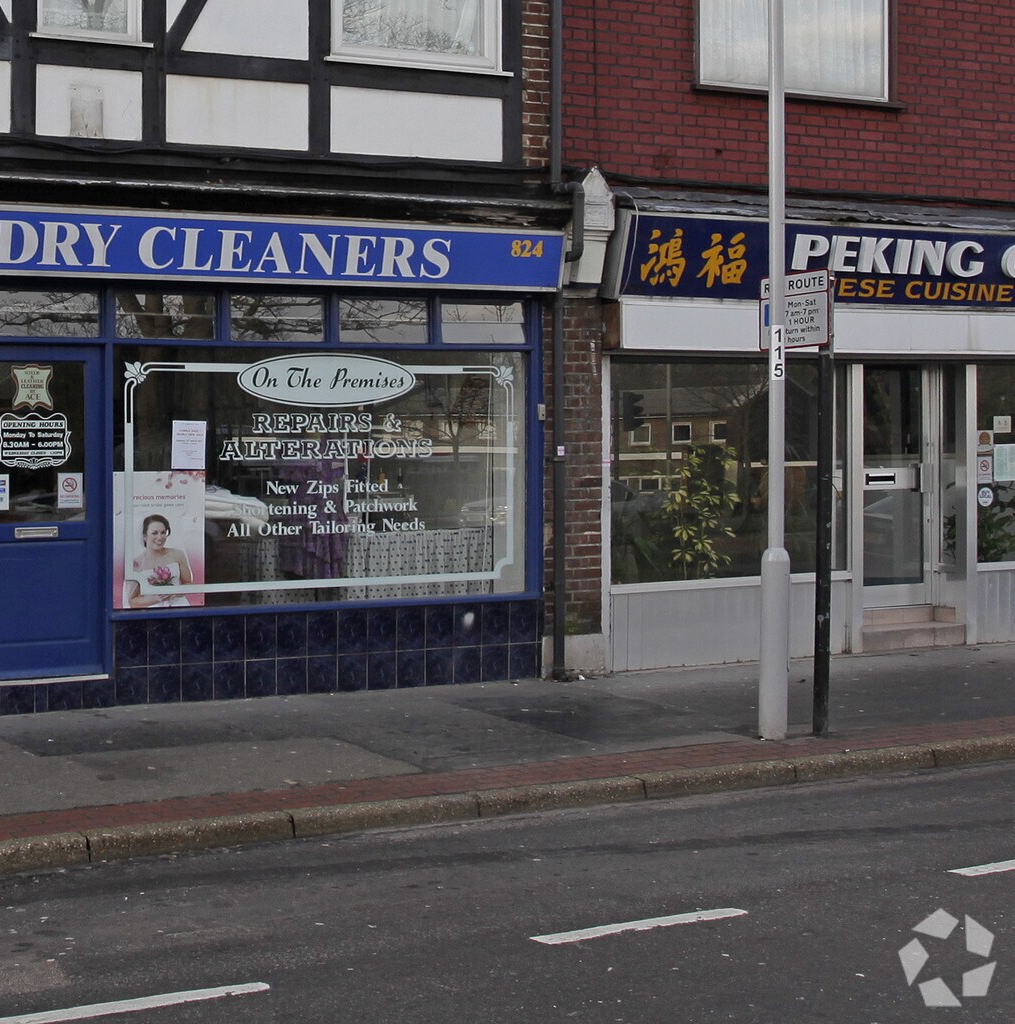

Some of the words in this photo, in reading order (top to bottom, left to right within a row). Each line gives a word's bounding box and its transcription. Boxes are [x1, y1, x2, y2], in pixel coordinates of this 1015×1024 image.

[138, 226, 451, 279] CLEANERS
[511, 239, 544, 258] 824
[791, 233, 985, 278] PEKING
[788, 276, 824, 290] ROUTE
[905, 280, 1012, 302] CUISINE
[787, 299, 817, 309] Mon-Sat
[785, 327, 799, 335] turn
[800, 325, 821, 334] within
[793, 316, 815, 325] HOUR
[787, 335, 806, 343] hours
[251, 366, 279, 388] On
[286, 367, 322, 388] The
[329, 367, 405, 390] Premises
[252, 412, 373, 434] REPAIRS
[383, 412, 402, 433] &
[219, 438, 433, 460] ALTERATIONS
[266, 480, 299, 495] New
[306, 480, 339, 499] Zips
[346, 479, 389, 493] Fitted
[324, 500, 337, 514] &
[346, 498, 418, 513] Patchwork
[227, 523, 251, 537] All
[258, 522, 303, 537] Other
[308, 520, 376, 536] Tailoring
[382, 518, 426, 532] Needs
